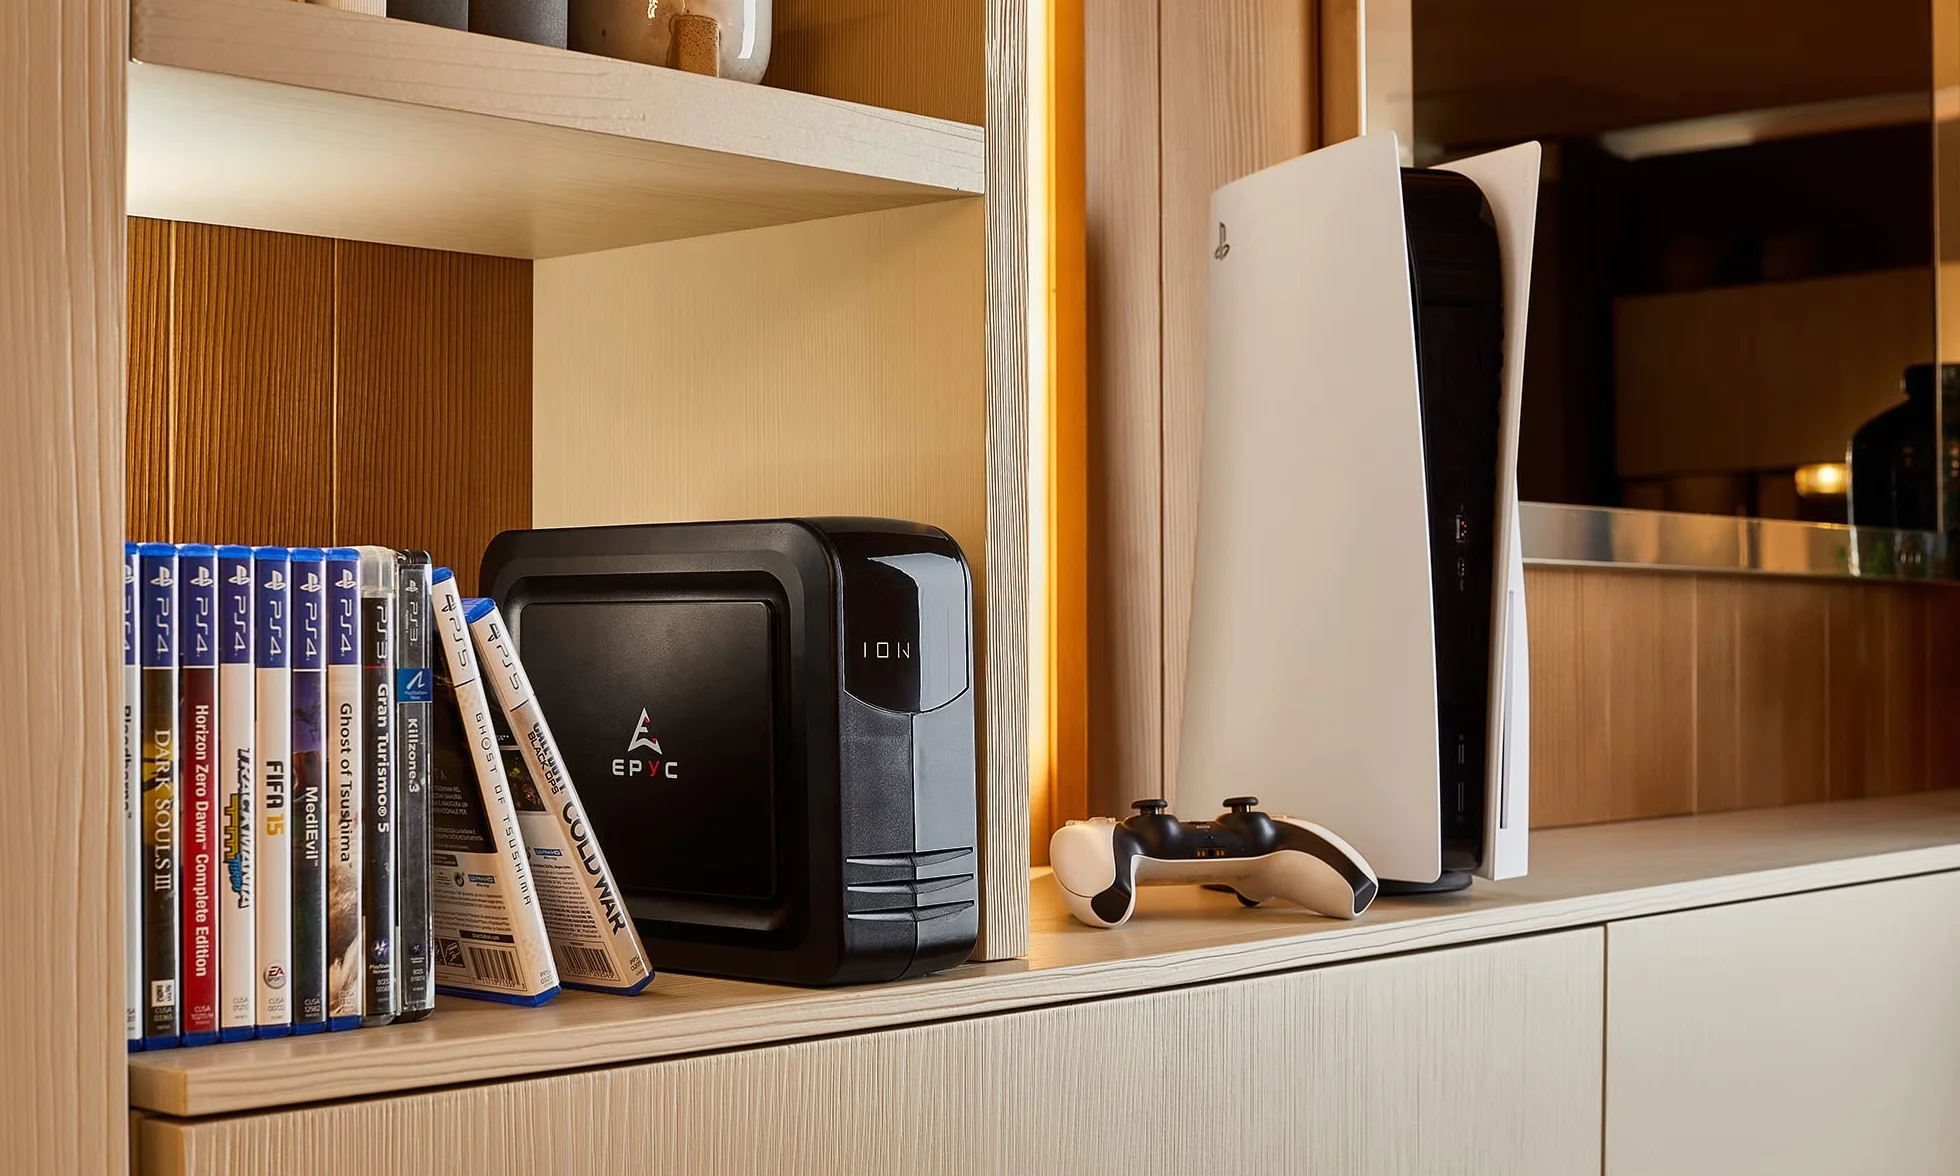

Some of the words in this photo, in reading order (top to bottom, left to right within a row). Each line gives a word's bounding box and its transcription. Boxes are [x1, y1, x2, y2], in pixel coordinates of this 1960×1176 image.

[156, 597, 169, 653] PS4
[195, 597, 209, 653] PS4
[233, 595, 247, 651] PS4
[269, 600, 282, 655] PS4
[304, 602, 317, 657] PS4
[340, 598, 352, 653] PS4
[376, 605, 388, 661] PS3
[409, 601, 419, 642] PS3
[450, 617, 471, 667] PS5
[497, 644, 523, 691] PS5
[863, 641, 910, 659] ION
[340, 703, 352, 753] Ghost
[378, 683, 389, 728] Gran
[195, 705, 209, 760] Horizon
[154, 730, 172, 791] DARK
[195, 764, 209, 797] Zero
[266, 761, 284, 808] FIFA
[340, 759, 352, 776] of
[528, 731, 550, 769] BLACK
[545, 770, 559, 795] OPS
[612, 758, 678, 779] EPYC
[267, 814, 284, 836] 15
[378, 822, 389, 833] 5
[476, 712, 497, 773] GHOST
[495, 784, 506, 805] OF
[503, 813, 532, 905] TSUSHIMA
[154, 798, 171, 870] SOULS
[154, 872, 171, 891] III
[193, 854, 209, 923] Complete
[562, 801, 602, 876] COLD
[594, 874, 626, 935] WAR
[195, 927, 209, 977] Edition
[268, 966, 285, 976] EA
[304, 998, 321, 1006] CUSA
